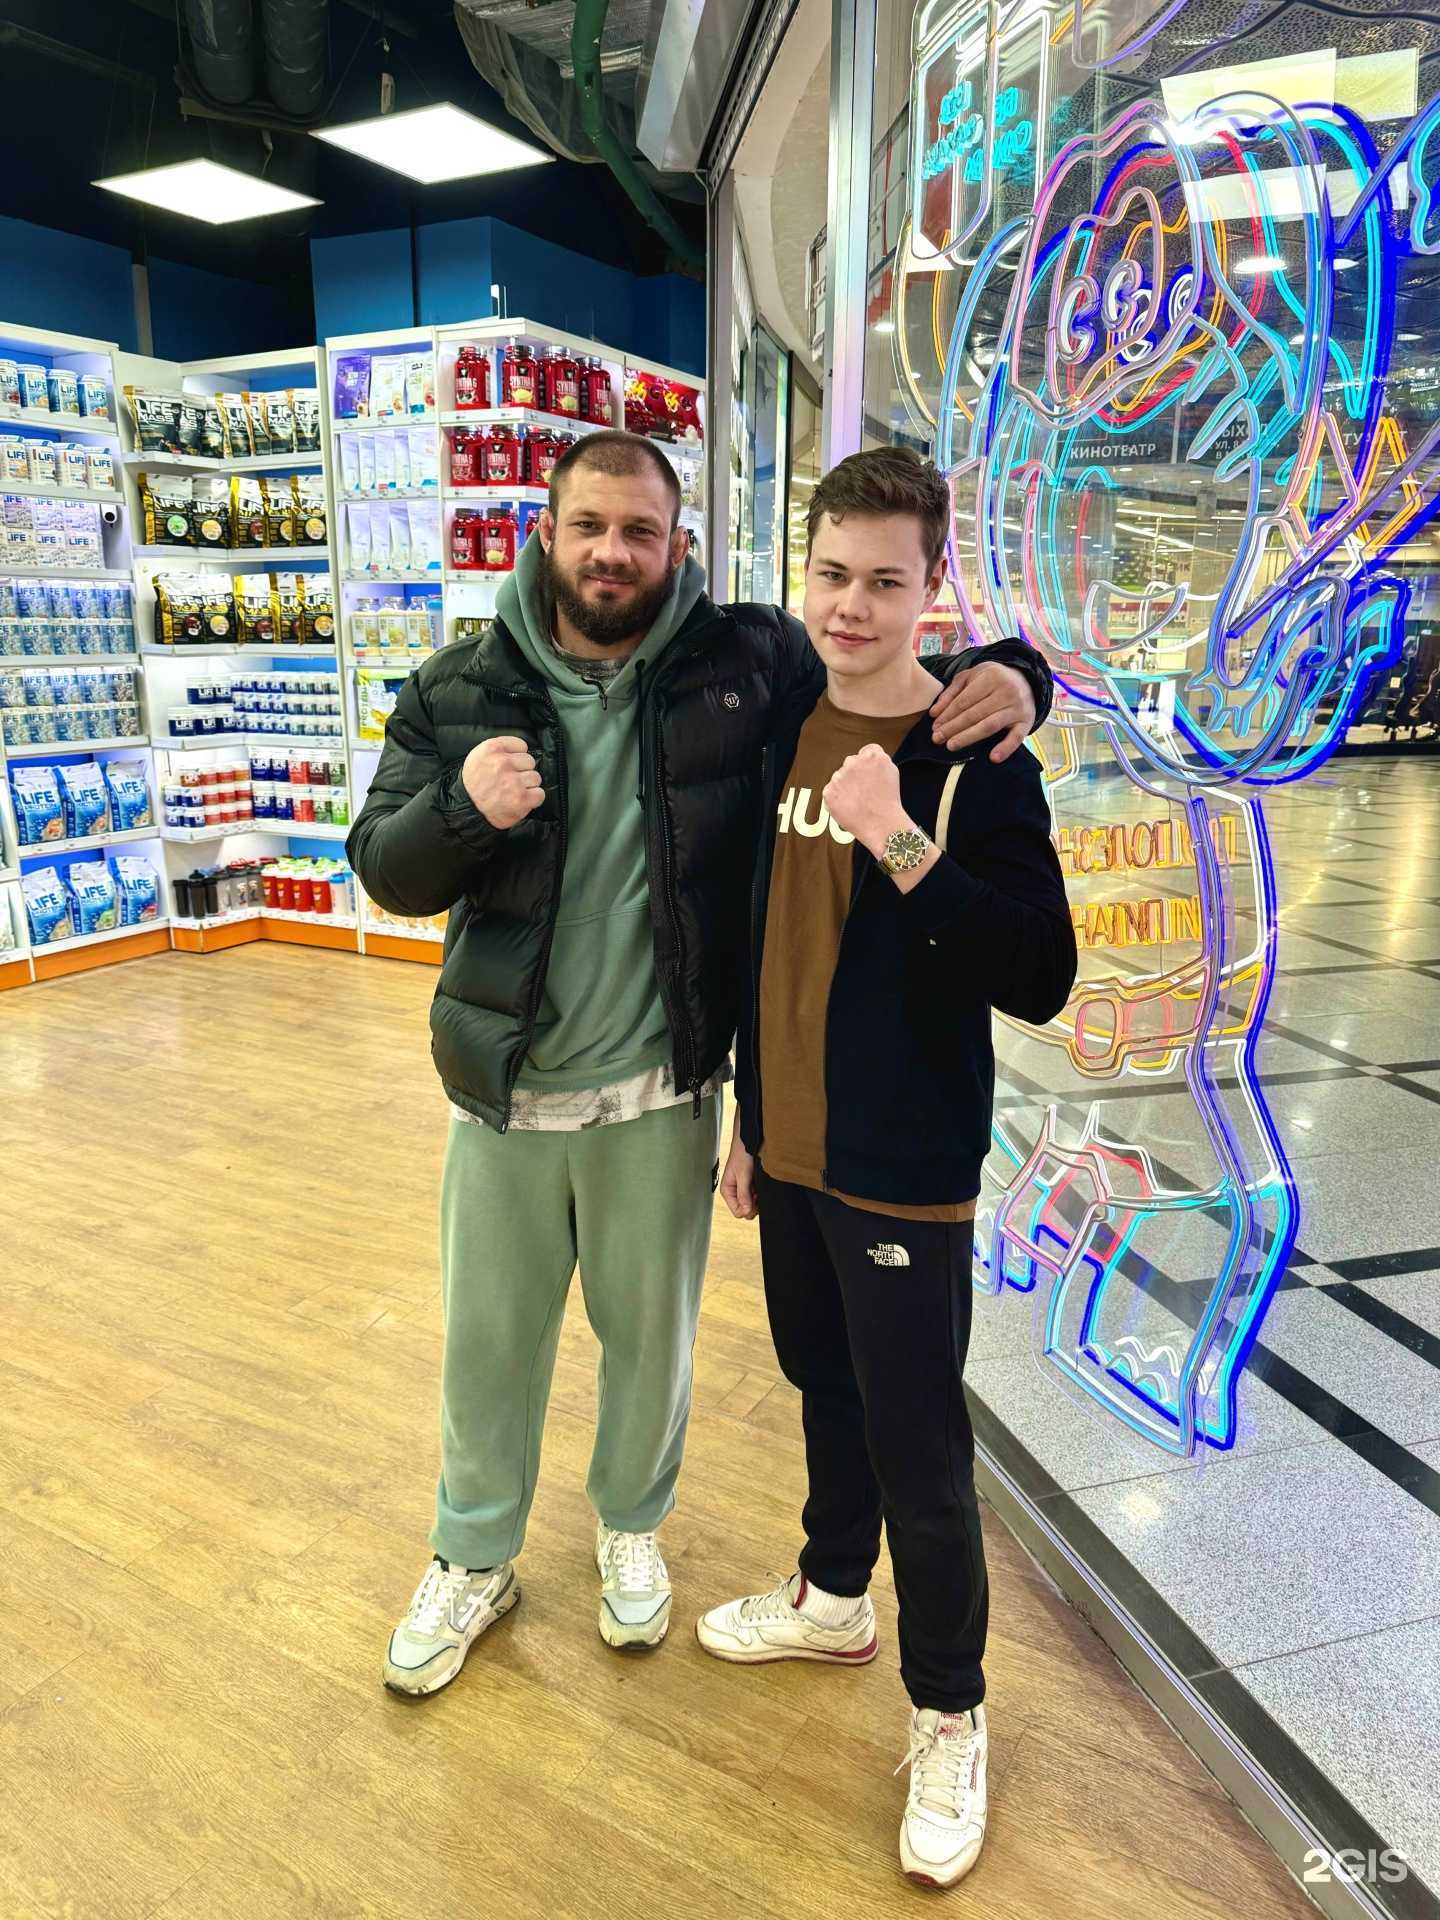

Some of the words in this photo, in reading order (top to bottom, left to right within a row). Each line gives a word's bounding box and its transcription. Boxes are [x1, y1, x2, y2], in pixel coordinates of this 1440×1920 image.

[136, 399, 173, 416] LIFE
[1071, 443, 1156, 459] КИНОТЕАТР
[93, 459, 113, 468] LIFE
[114, 781, 141, 794] LIFE
[21, 791, 55, 805] LIFE
[71, 788, 101, 803] LIFE
[125, 879, 154, 891] LIFE
[77, 885, 108, 899] LIFE
[27, 892, 59, 911] LIFE
[867, 1248, 894, 1260] NORTH
[877, 1243, 894, 1252] THE
[874, 1256, 895, 1266] FACE
